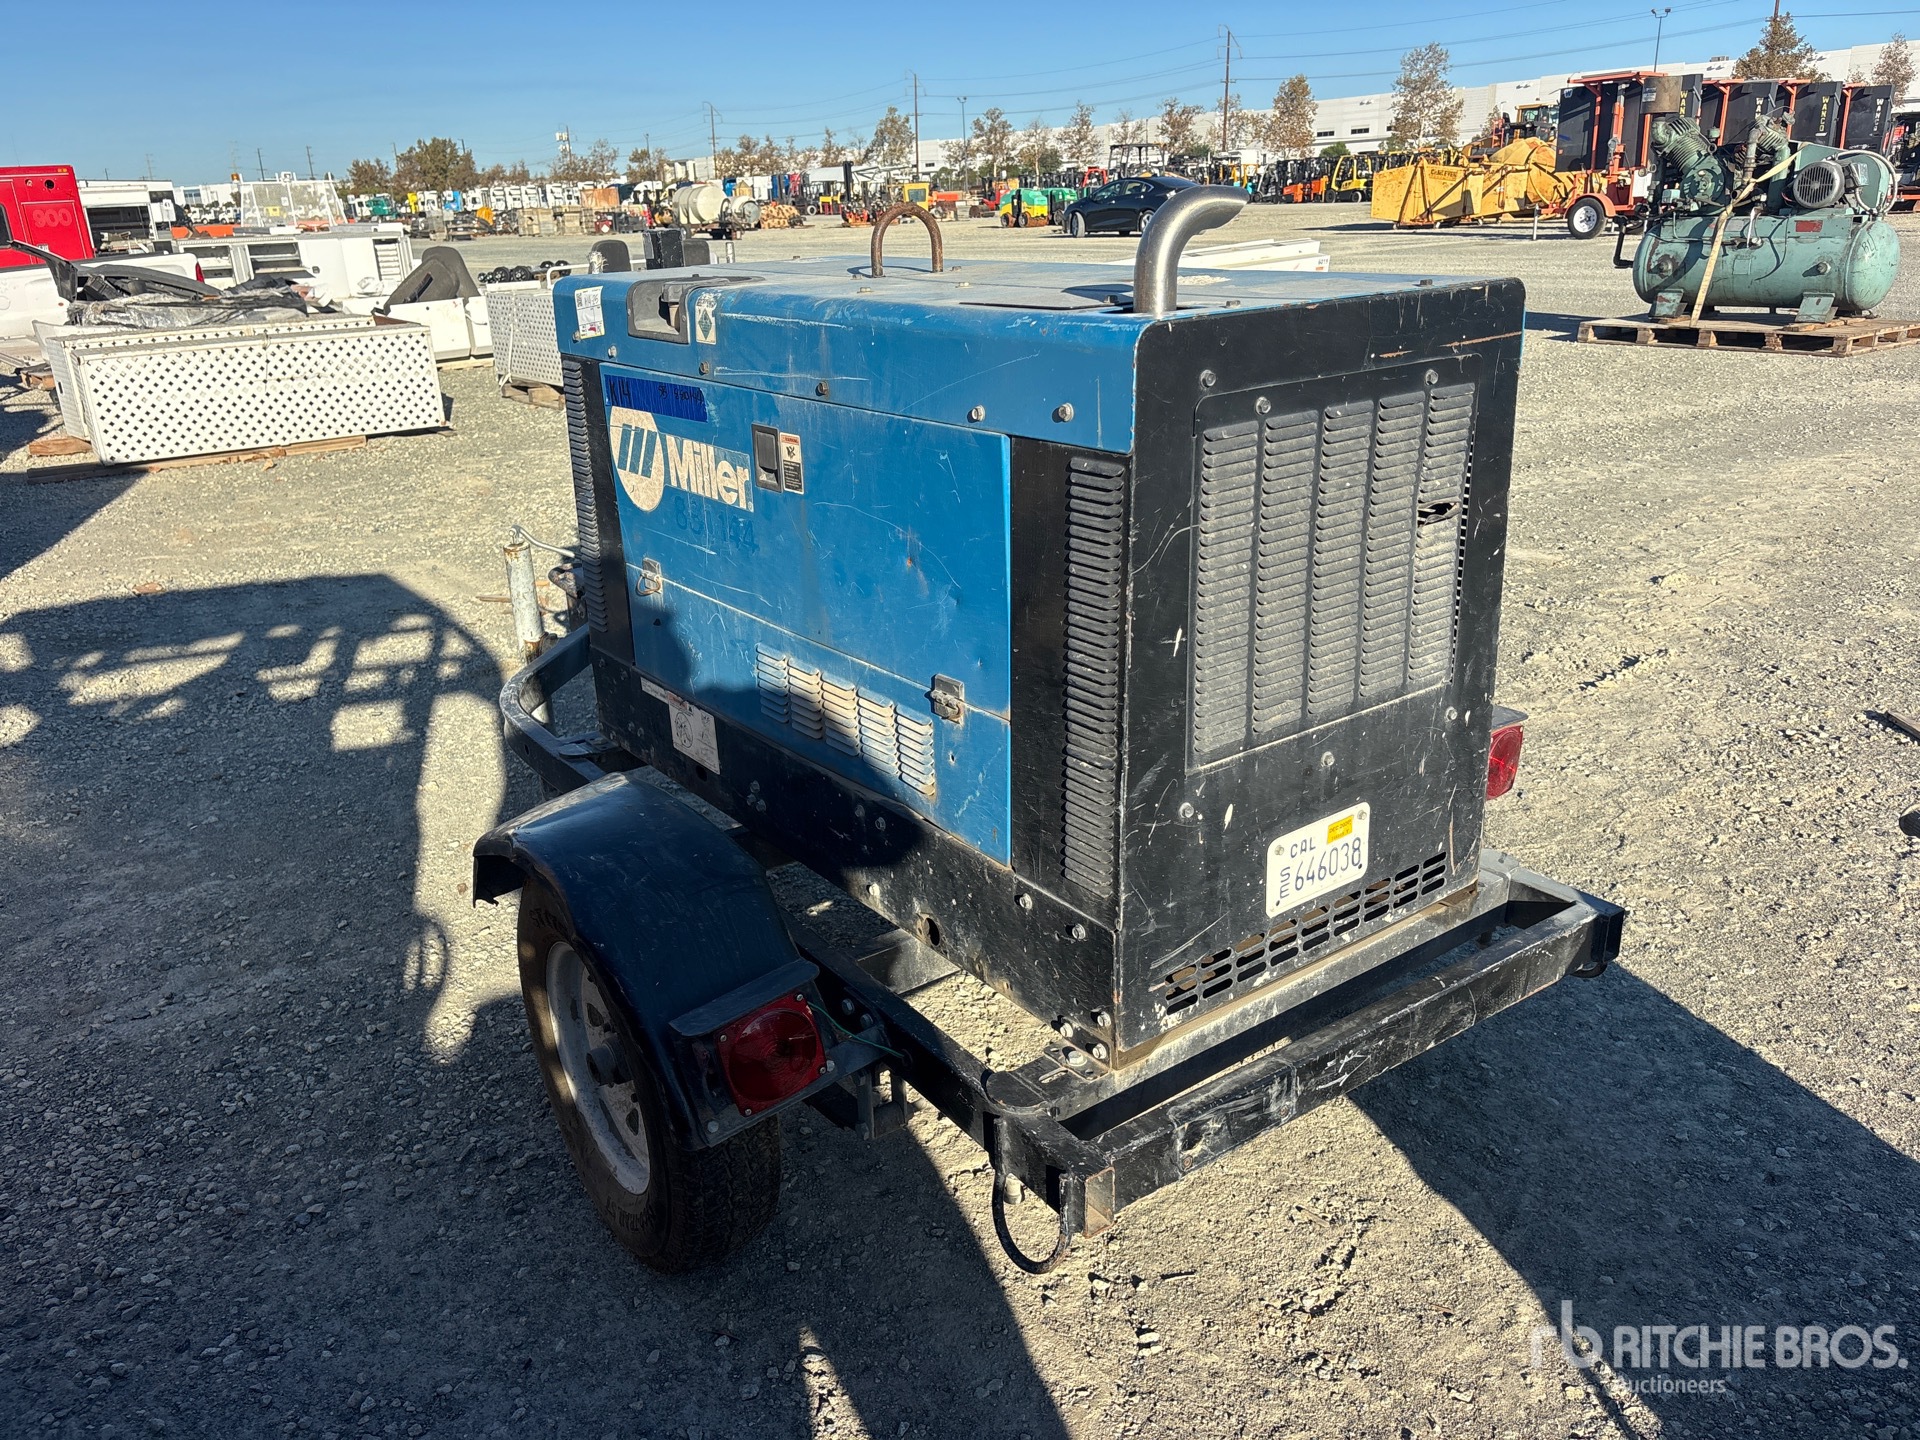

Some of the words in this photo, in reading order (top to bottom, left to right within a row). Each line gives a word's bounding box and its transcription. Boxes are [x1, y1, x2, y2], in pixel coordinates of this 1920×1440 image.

[1819, 95, 1830, 132] WANCO
[1872, 98, 1885, 132] WANCO
[32, 208, 73, 228] 900
[666, 434, 750, 510] Miller
[1290, 837, 1317, 859] CAL
[1294, 837, 1361, 891] 646038
